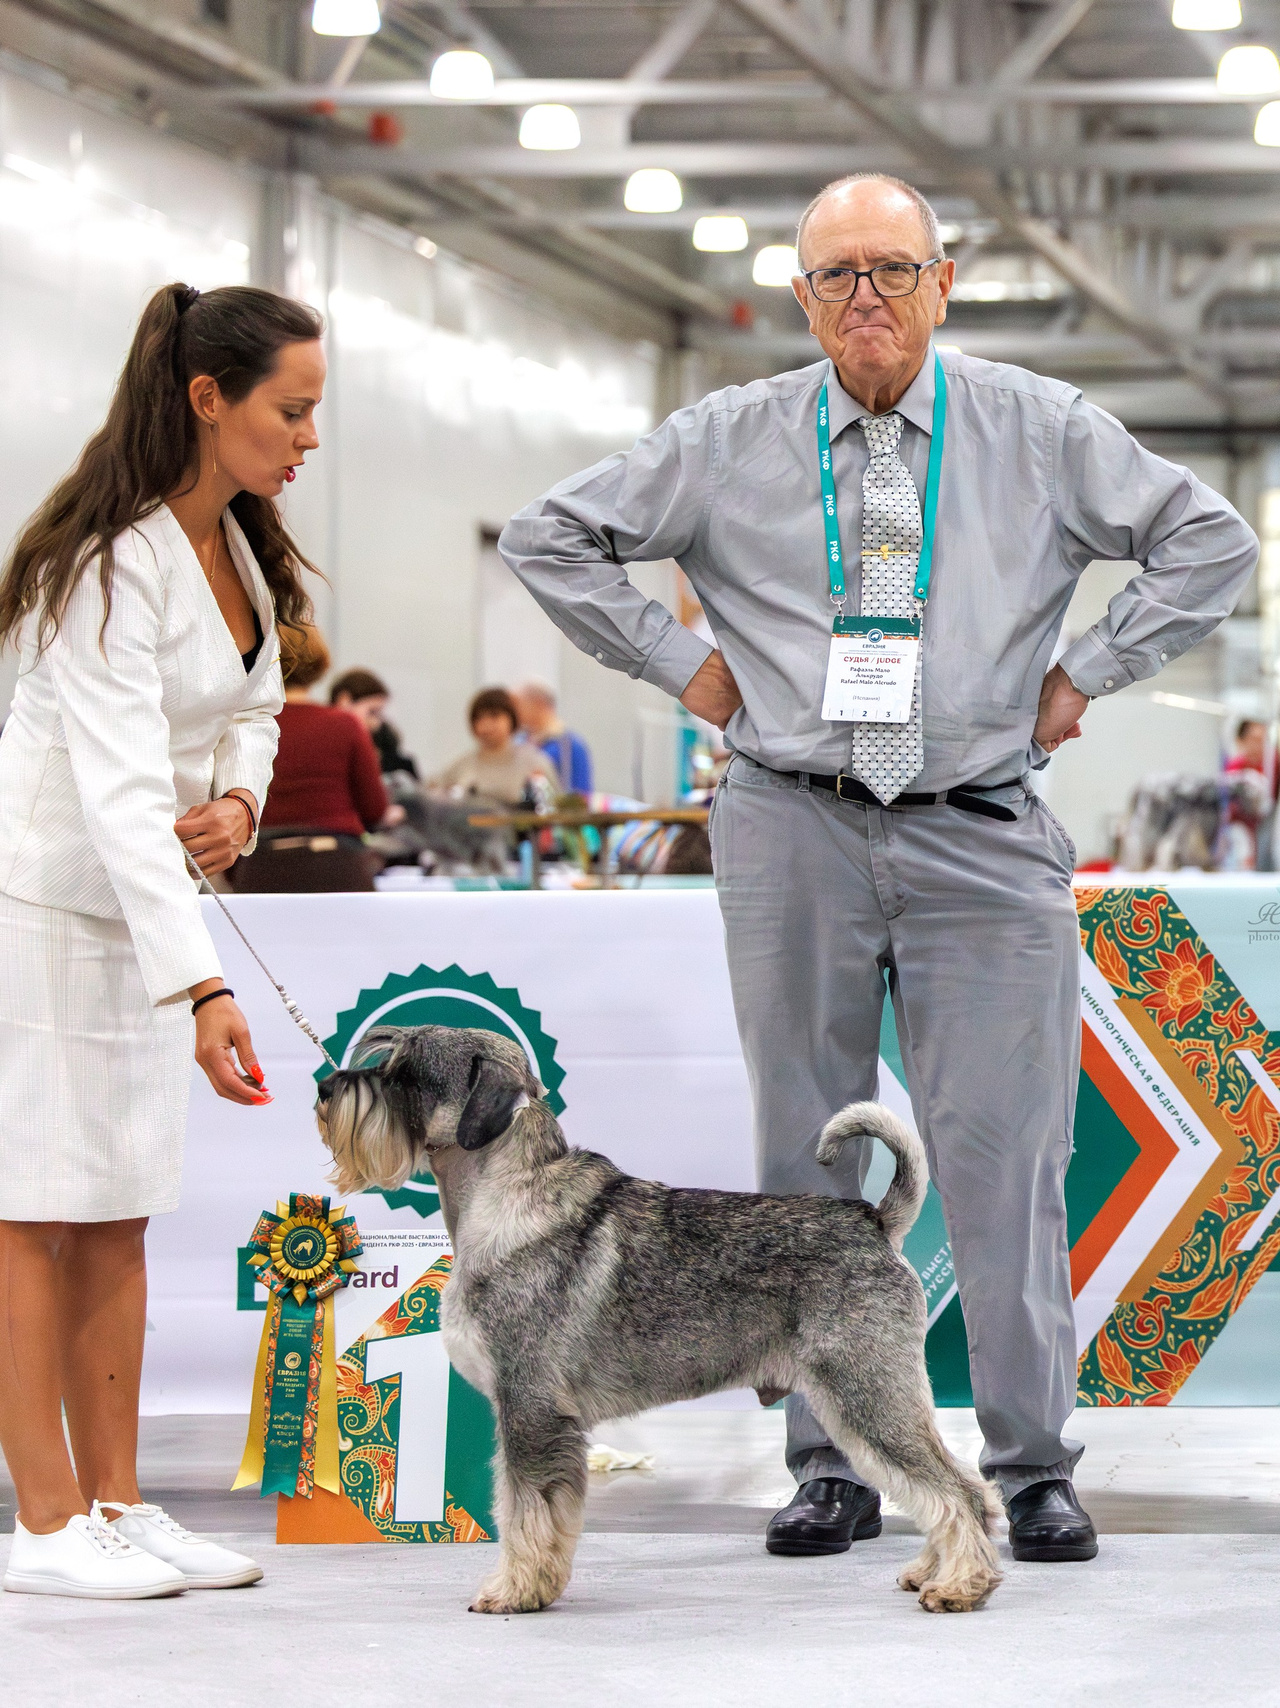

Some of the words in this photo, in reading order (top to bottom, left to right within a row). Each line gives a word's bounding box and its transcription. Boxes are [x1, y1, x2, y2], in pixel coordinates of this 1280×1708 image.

[822, 450, 830, 470] РКФ
[825, 495, 834, 516] РКФ
[830, 541, 840, 562] РКФ
[1081, 986, 1153, 1082] КИНОЛОГИЧЕСКАЯ
[1152, 1084, 1201, 1147] ФЕДЕРАЦИЯ
[366, 1330, 450, 1522] 1
